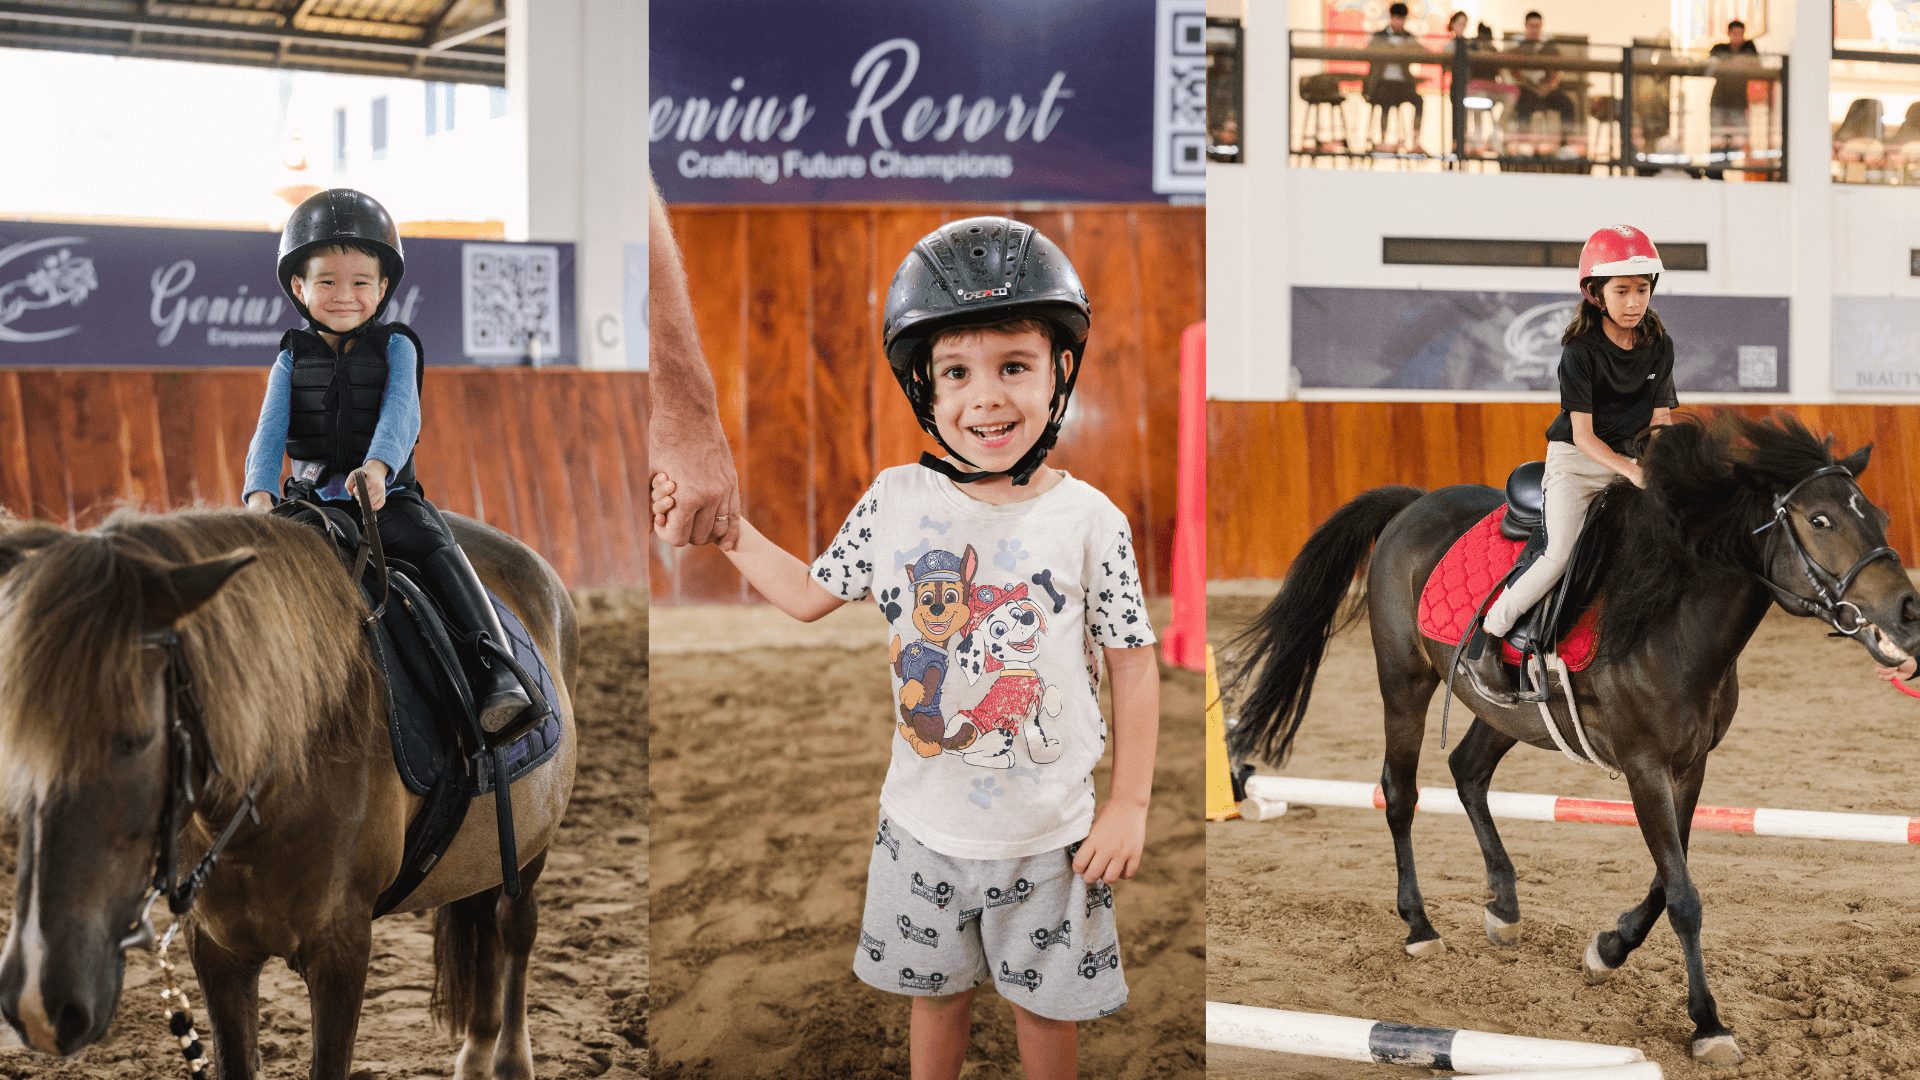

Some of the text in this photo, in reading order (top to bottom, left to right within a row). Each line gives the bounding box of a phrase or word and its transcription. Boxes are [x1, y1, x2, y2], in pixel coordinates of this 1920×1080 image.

[649, 38, 1075, 149] enius Resort
[677, 150, 1014, 184] Crafting Future Champions
[150, 259, 287, 347] Genius
